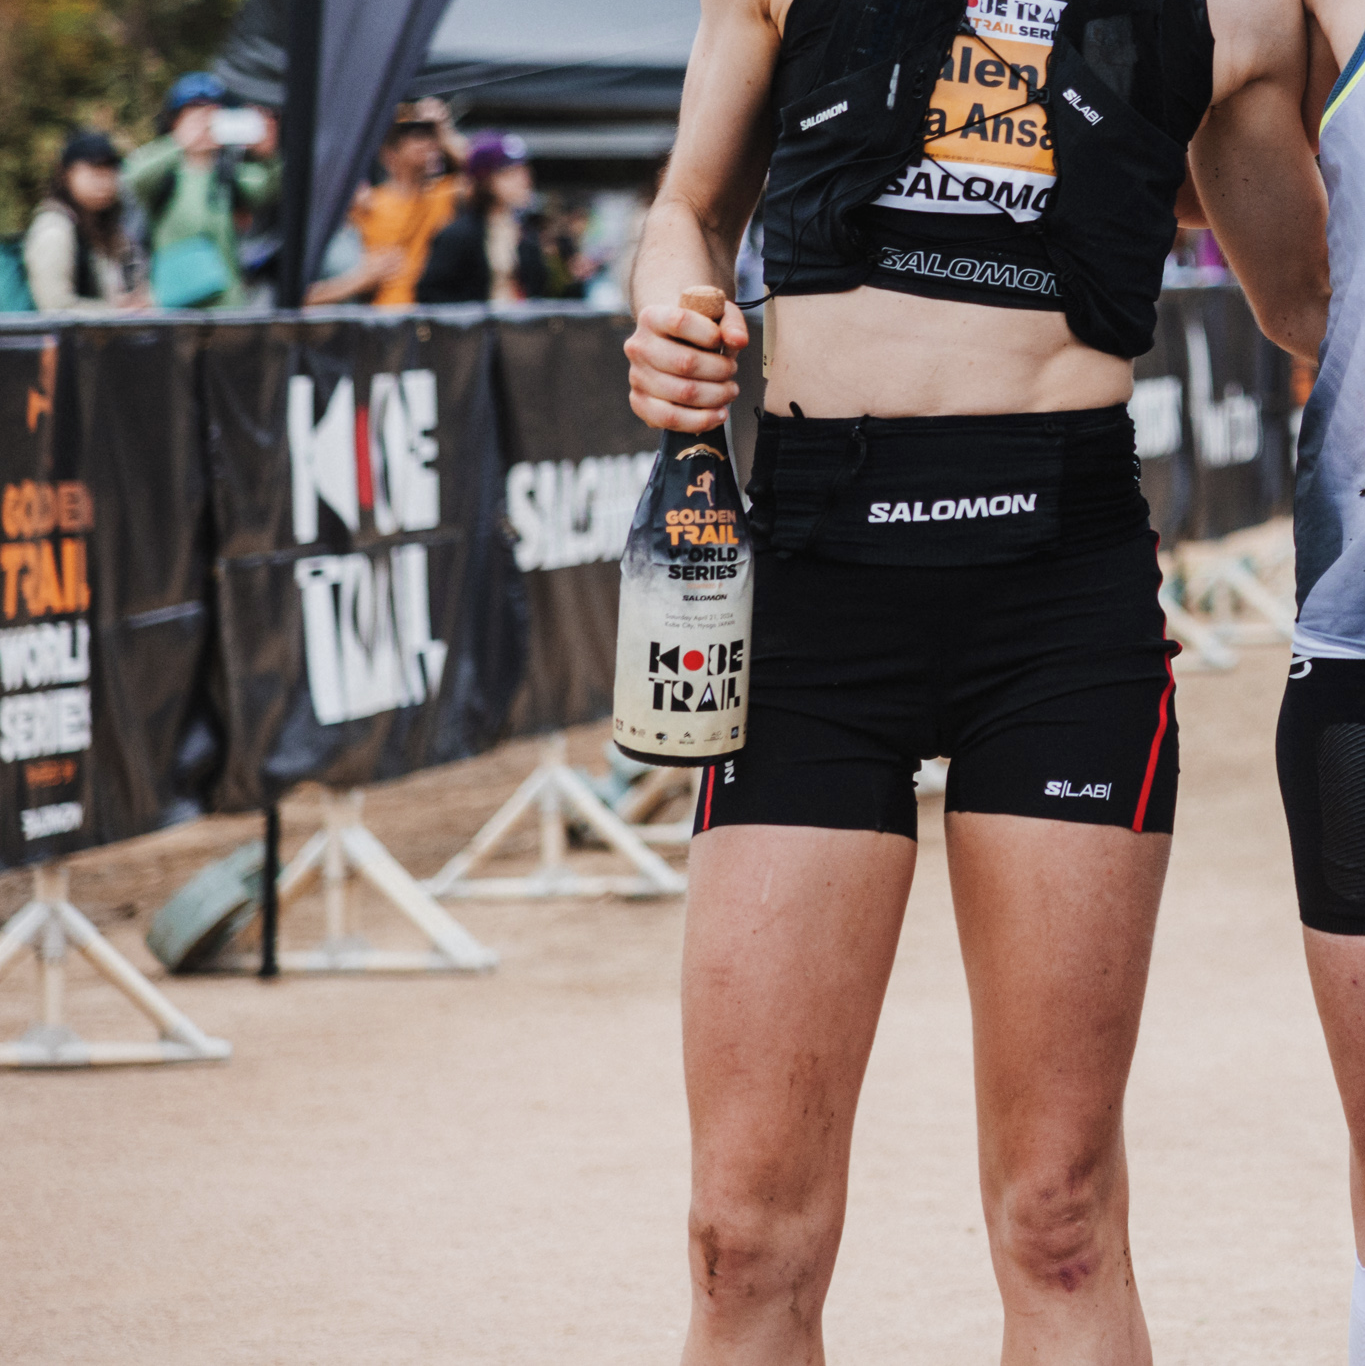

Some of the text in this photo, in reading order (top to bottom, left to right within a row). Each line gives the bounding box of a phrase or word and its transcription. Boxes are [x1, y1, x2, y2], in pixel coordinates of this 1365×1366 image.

[800, 100, 848, 131] SALOMON
[665, 508, 737, 525] GOLDEN
[867, 492, 1037, 523] SALOMON
[665, 525, 739, 546] TRAIL
[668, 546, 738, 563] WORLD
[668, 564, 738, 581] SERIES
[682, 594, 727, 602] SALOMON
[649, 639, 744, 676] KOBE
[648, 676, 741, 712] TRAIL
